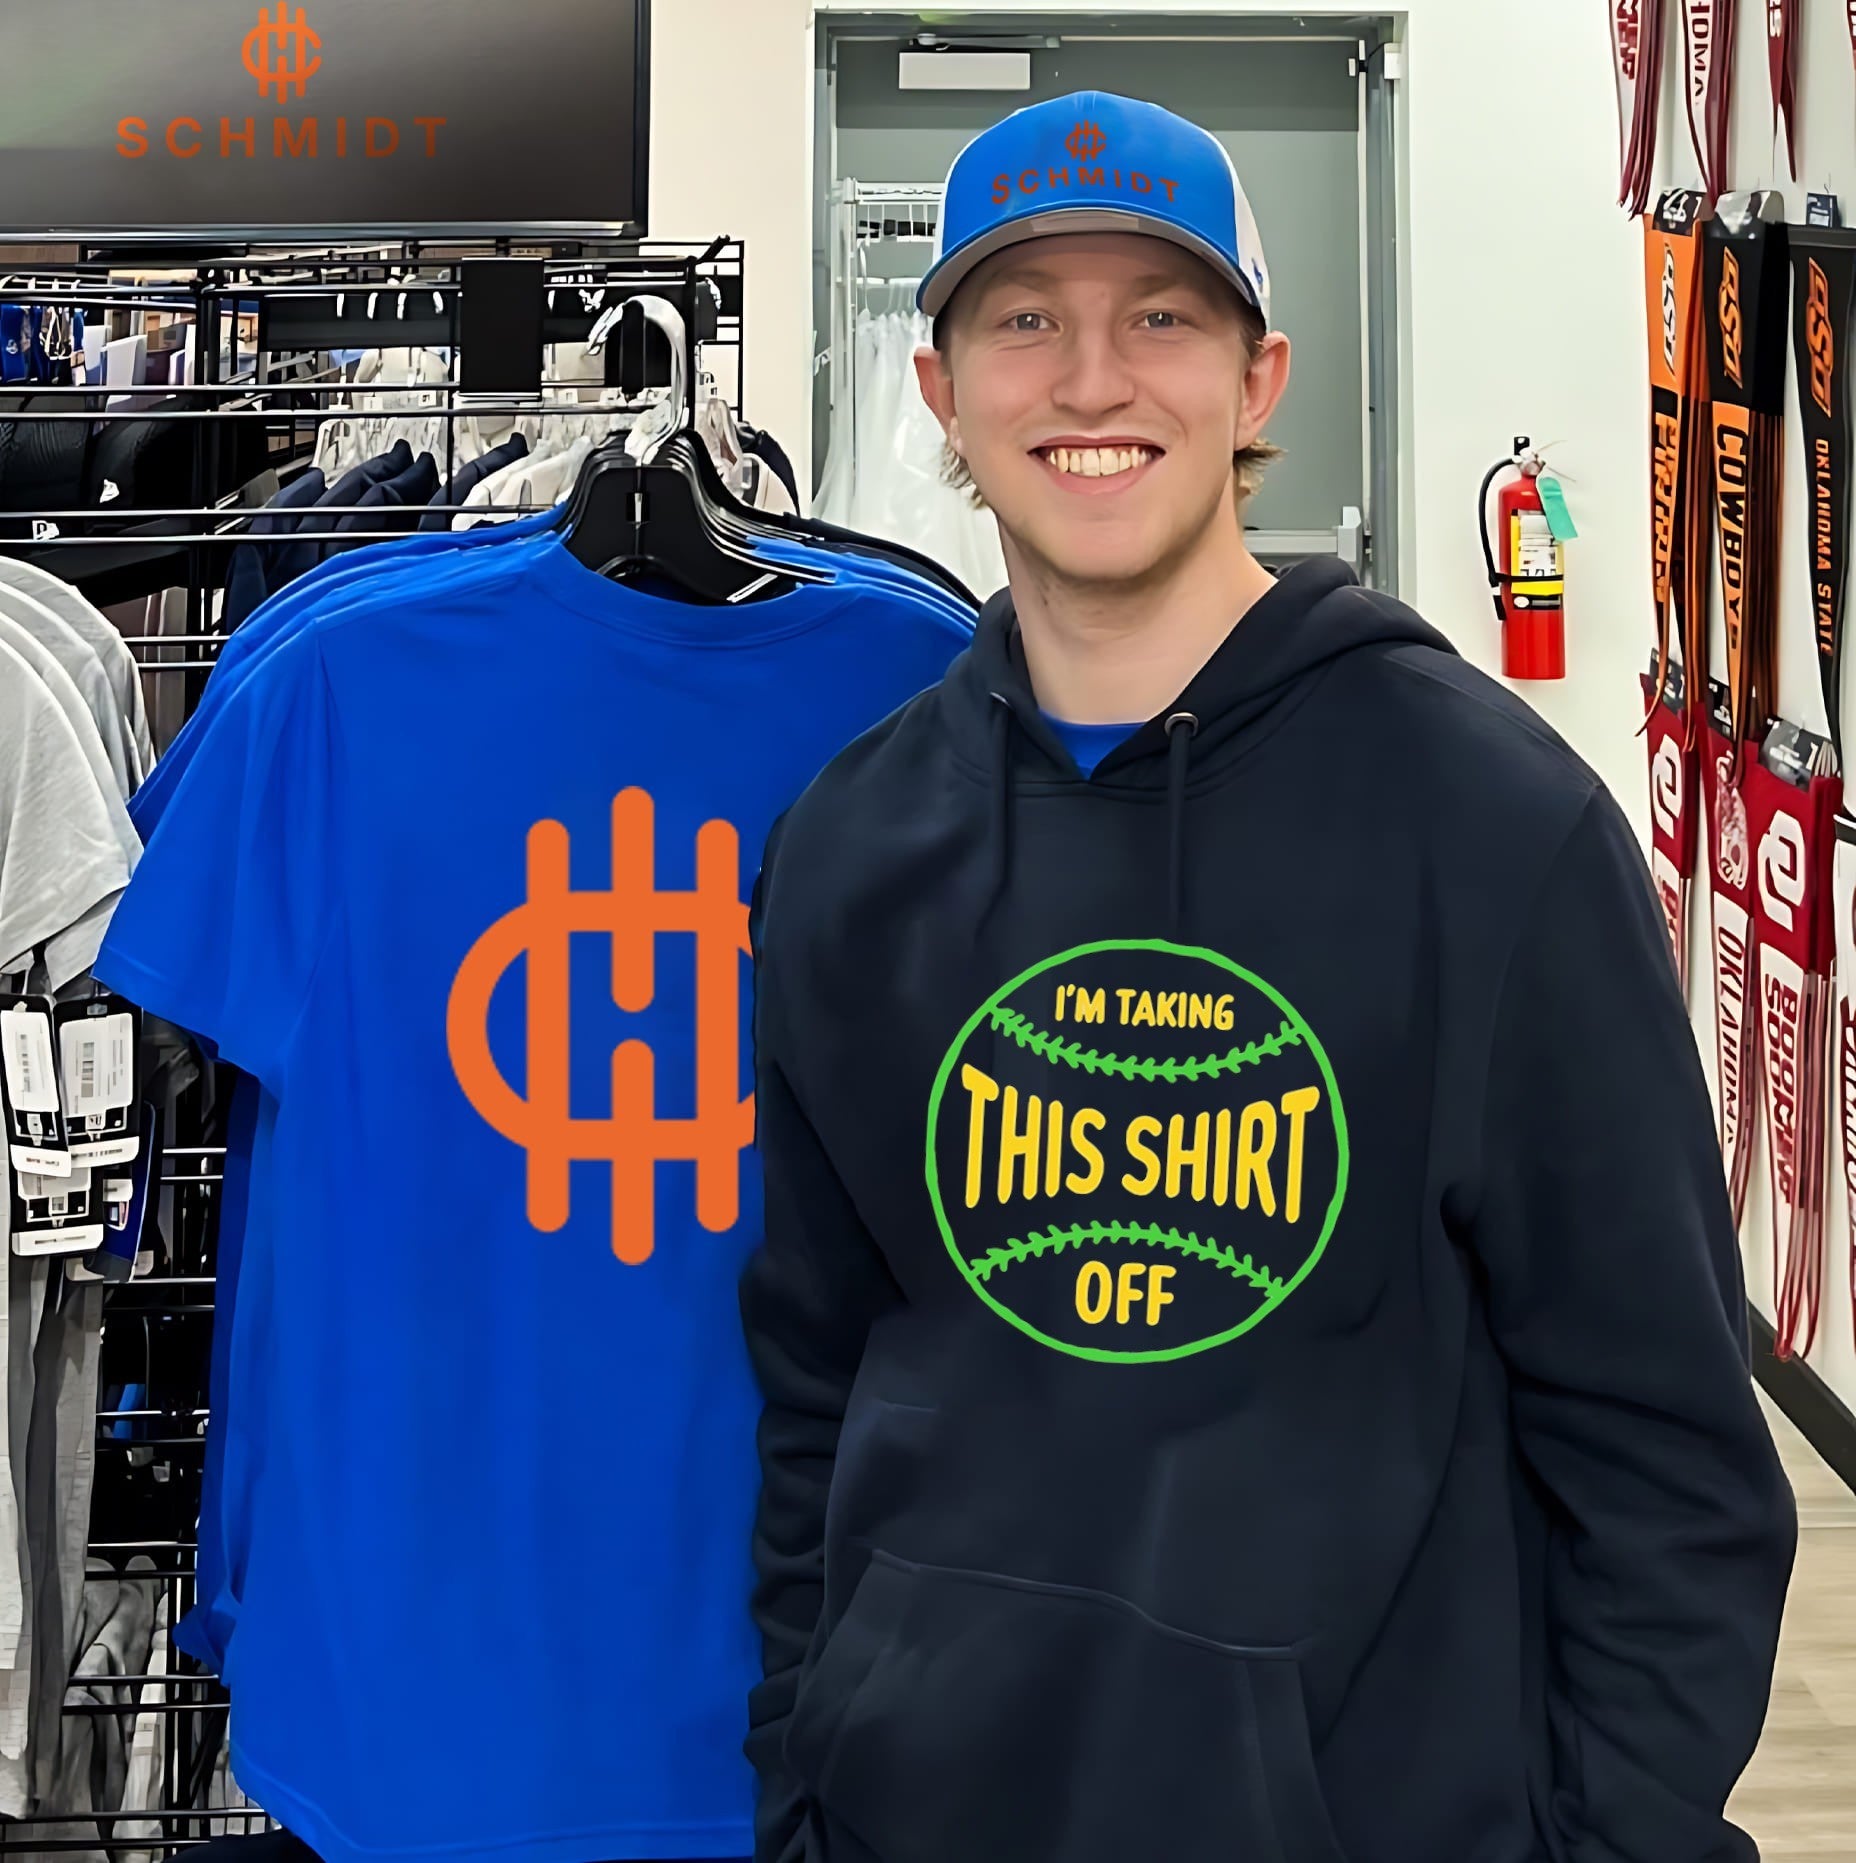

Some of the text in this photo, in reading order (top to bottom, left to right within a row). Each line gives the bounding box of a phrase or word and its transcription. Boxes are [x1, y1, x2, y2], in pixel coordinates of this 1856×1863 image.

[115, 116, 447, 159] SCHMIDT
[991, 166, 1180, 205] SCHMIDT
[1815, 438, 1832, 571] OKLAHOMA
[1054, 984, 1236, 1031] I'M TAKING
[1718, 926, 1745, 1144] OKLAHOMA
[961, 1062, 1321, 1224] THIS SHIRT
[1074, 1260, 1177, 1327] OFF
